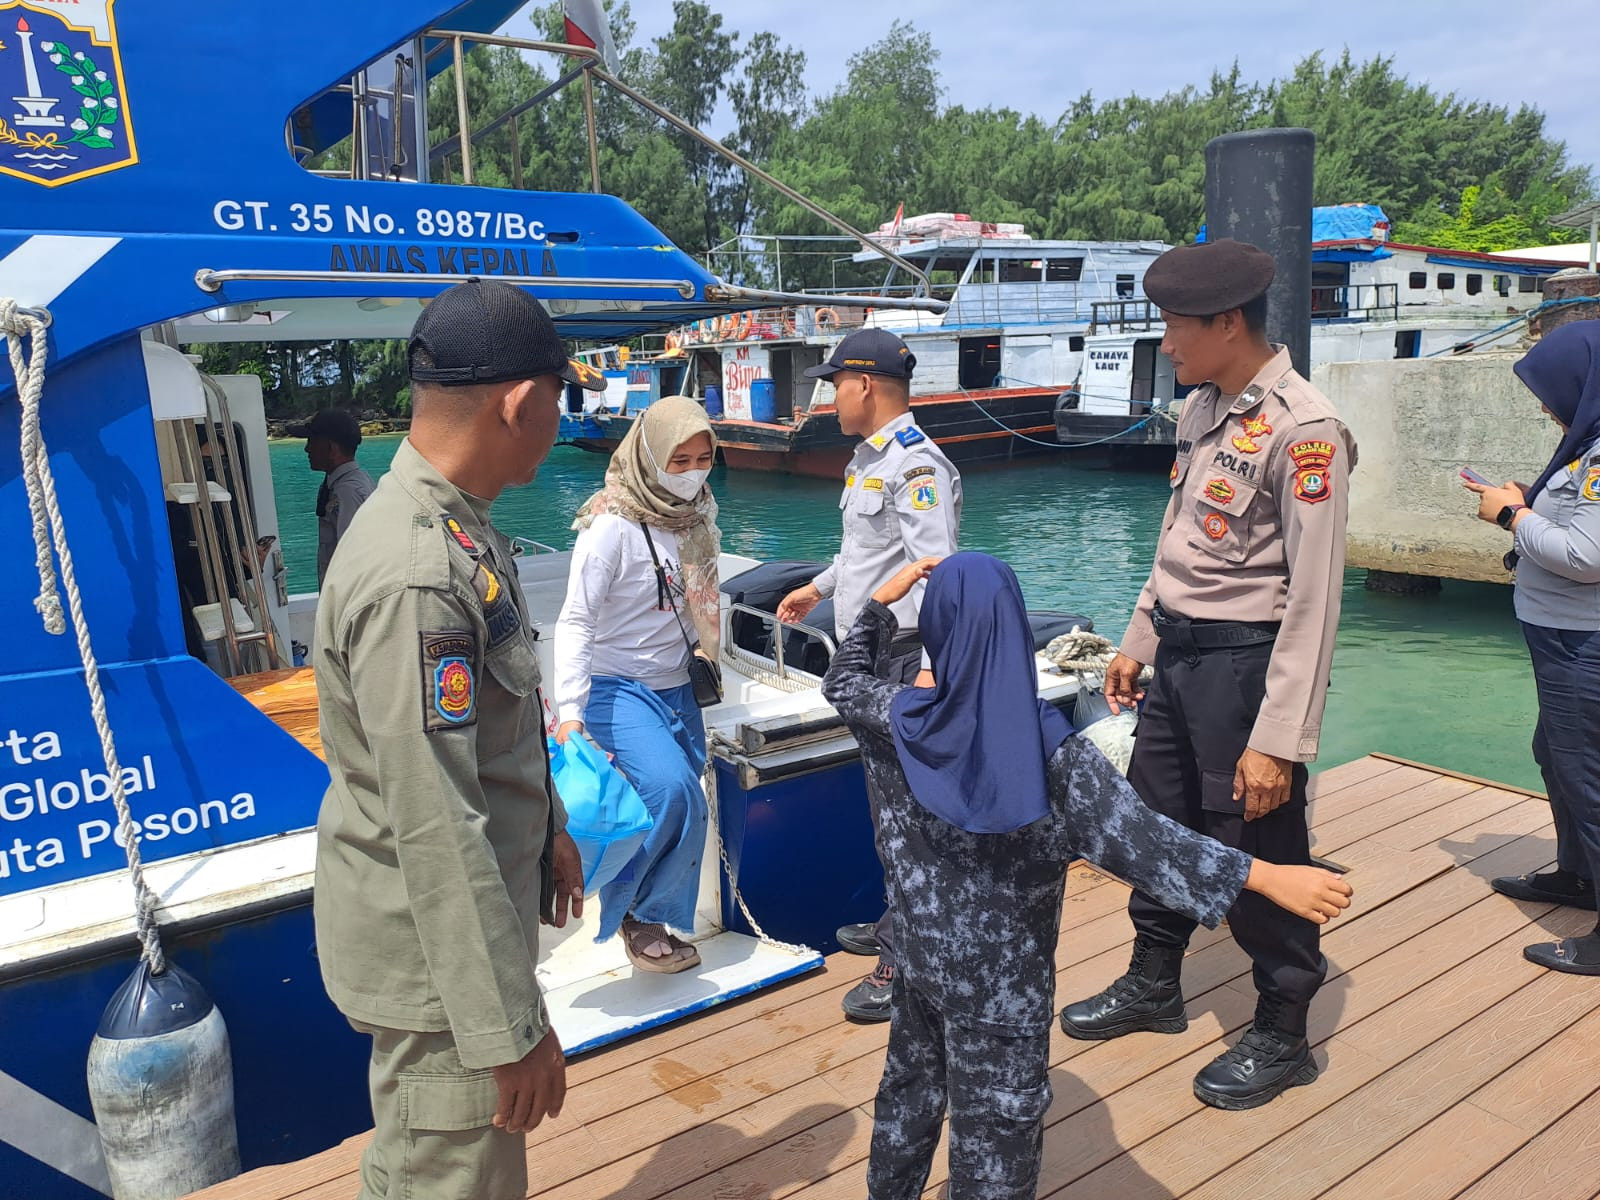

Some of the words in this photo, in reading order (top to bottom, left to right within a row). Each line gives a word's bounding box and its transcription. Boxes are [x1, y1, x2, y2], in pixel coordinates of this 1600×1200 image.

[213, 200, 278, 231] GT.
[290, 203, 333, 232] 35
[345, 205, 405, 234] No.
[416, 208, 546, 240] 8987/Bc
[330, 244, 427, 273] AWAS
[437, 247, 558, 277] KEPALA
[1095, 362, 1120, 370] LAUT
[1214, 451, 1257, 479] POLRI
[1293, 442, 1332, 454] POLRES
[0, 729, 62, 765] ta
[0, 755, 156, 821] Global
[78, 792, 256, 859] Pesona
